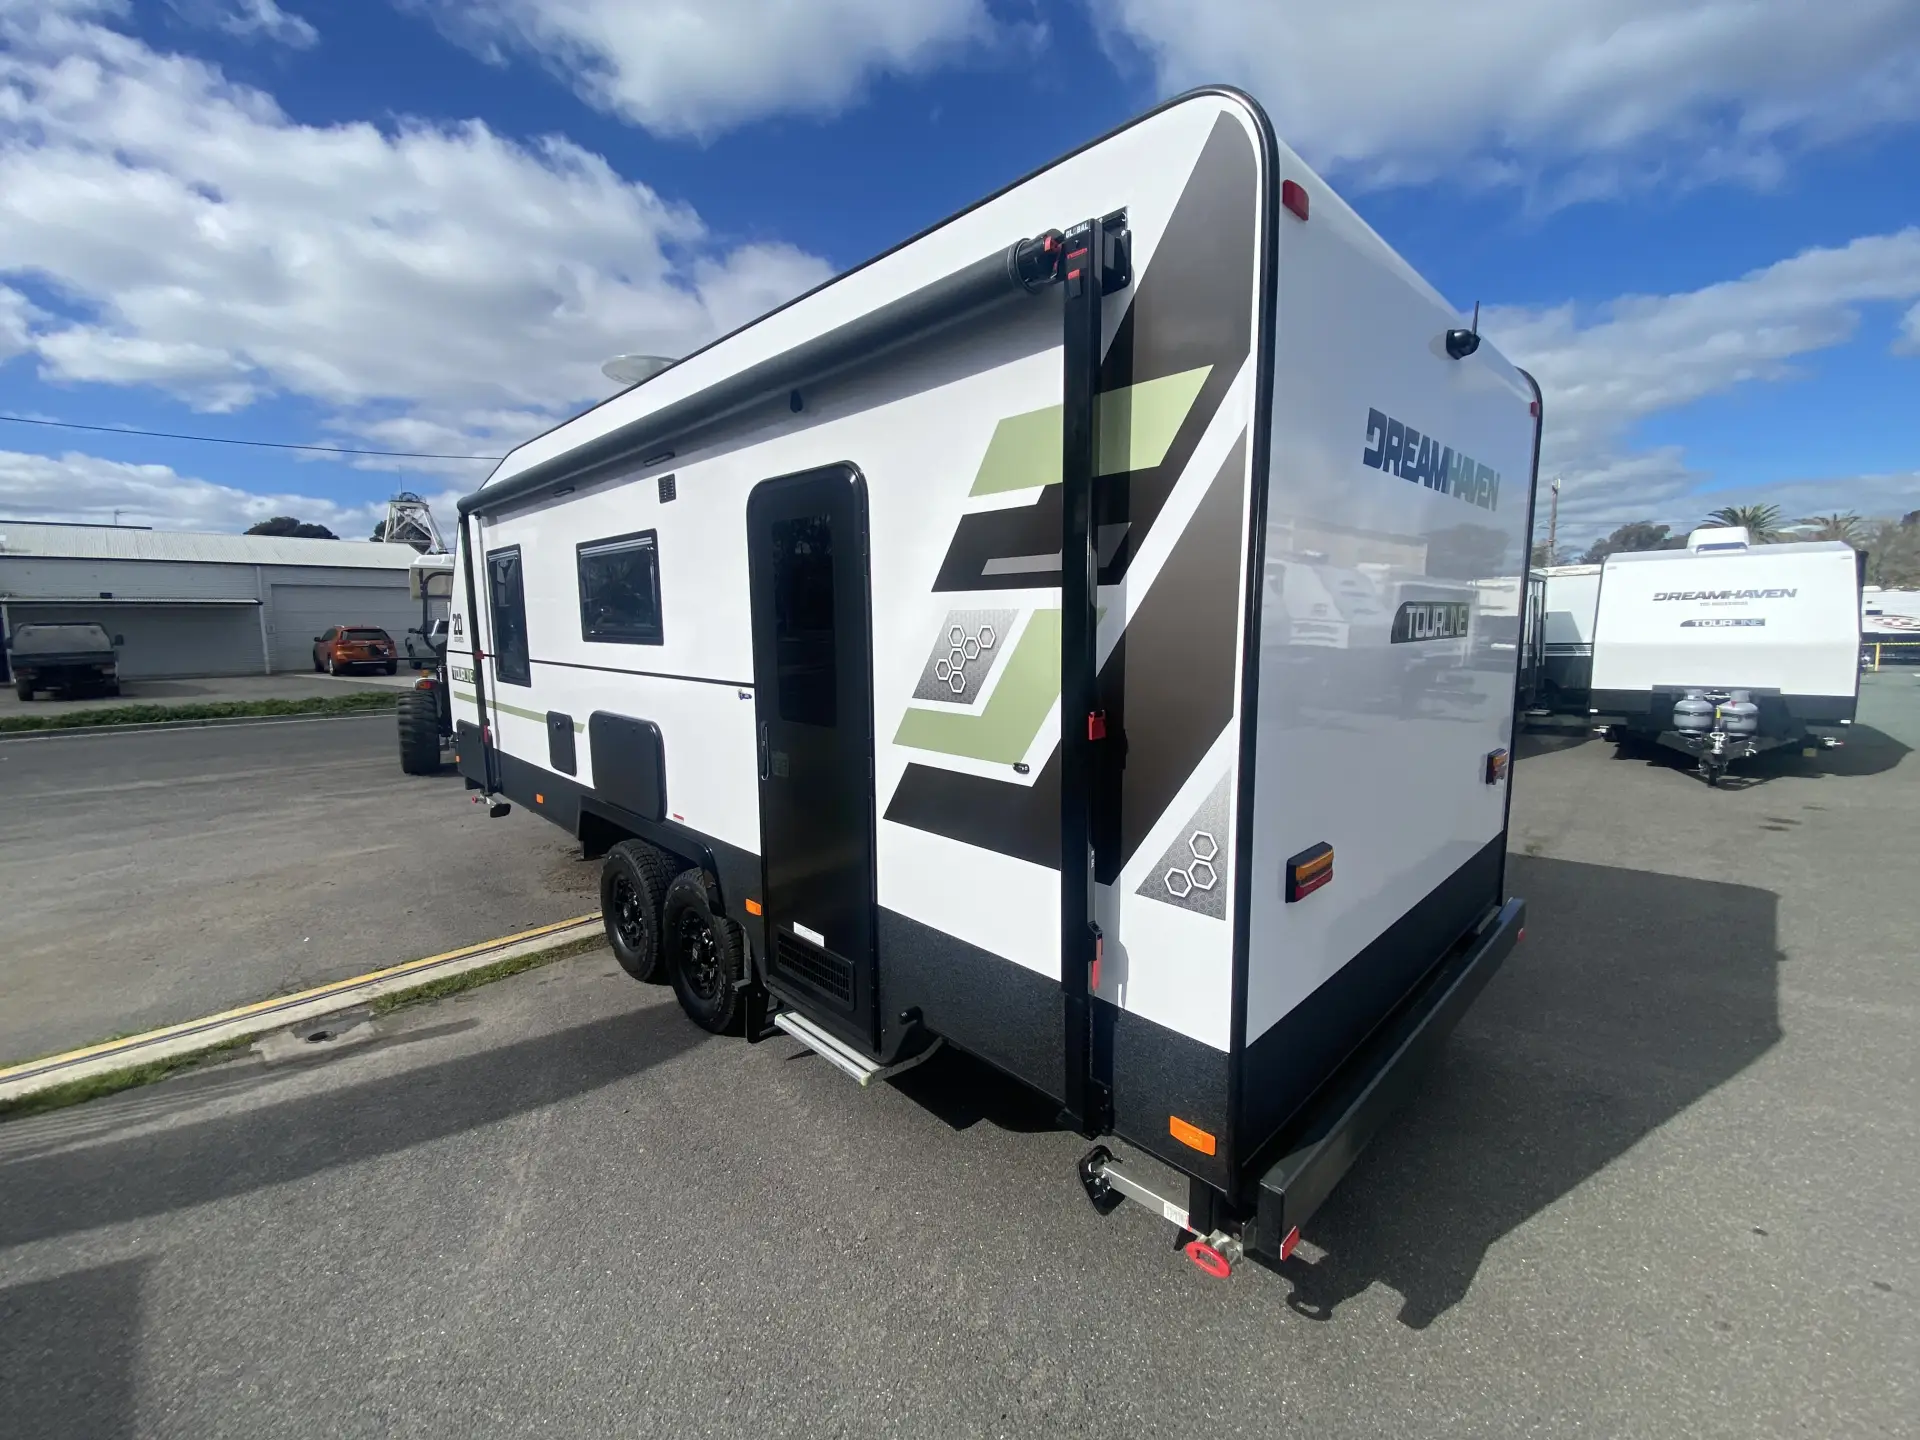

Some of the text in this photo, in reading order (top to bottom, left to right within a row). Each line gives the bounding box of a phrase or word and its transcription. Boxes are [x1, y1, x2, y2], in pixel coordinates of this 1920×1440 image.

[1066, 223, 1088, 238] GLOBAL
[1363, 407, 1500, 511] DREAMHAVEN
[1652, 588, 1798, 601] DREAMHAVEN
[453, 613, 463, 635] 20
[1406, 605, 1467, 639] TOURLINE
[1692, 618, 1761, 627] TOURLINE
